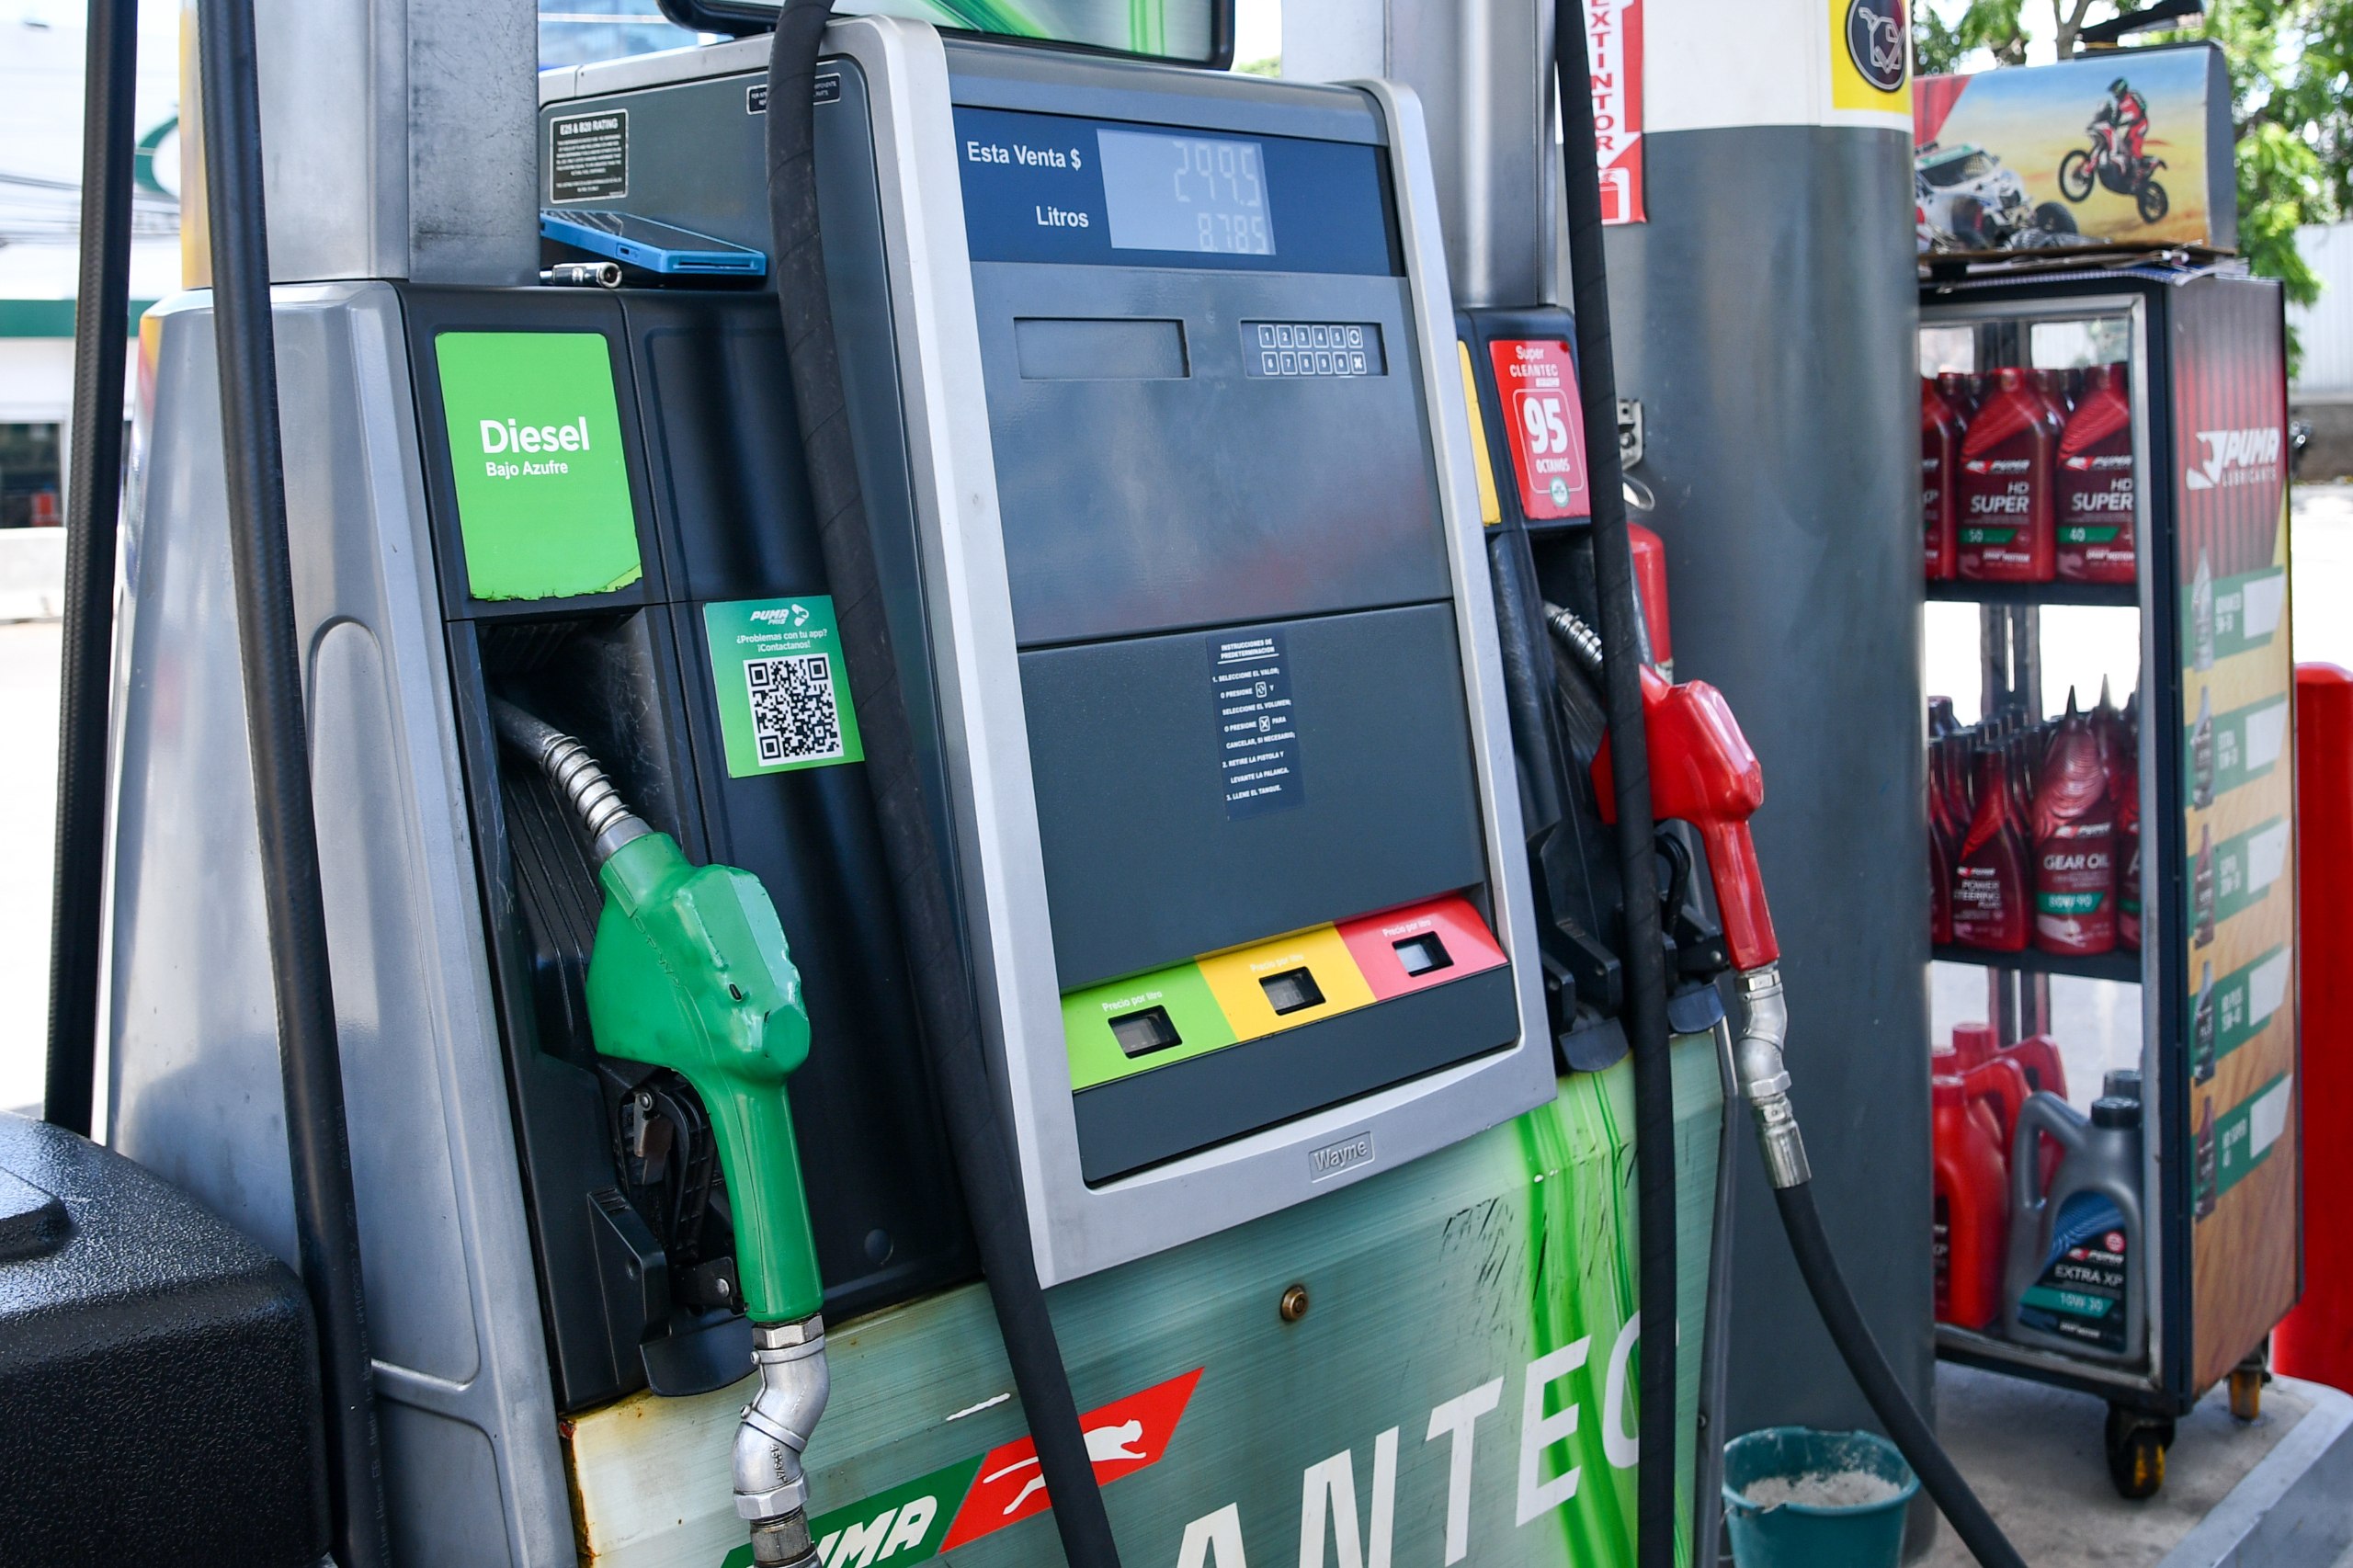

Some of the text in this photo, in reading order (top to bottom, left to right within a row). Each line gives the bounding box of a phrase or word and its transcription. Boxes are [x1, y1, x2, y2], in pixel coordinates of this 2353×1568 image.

[592, 118, 619, 131] RATING
[967, 141, 1082, 171] Esta Venta $
[1036, 205, 1089, 228] Litros
[1265, 332, 1340, 341] 1 2 3 4 5
[1516, 345, 1544, 362] Super
[1267, 358, 1274, 368] 6
[1286, 358, 1290, 368] 7
[1321, 358, 1326, 368] 9
[1338, 358, 1344, 368] 0
[1509, 363, 1559, 378] CLEANTEC
[1523, 397, 1567, 454] 95
[480, 416, 590, 453] Diesel
[2222, 427, 2280, 468] PUMA
[485, 460, 569, 480] Bajo Azufre
[1536, 458, 1571, 473] OCTANOS
[2007, 482, 2029, 494] HD
[2111, 478, 2132, 492] HD
[1971, 496, 2029, 514] SUPER
[2072, 493, 2133, 511] SUPER
[750, 608, 790, 621] PUMA
[736, 628, 827, 644] ¿Problemas con tu app?
[1221, 638, 1273, 652] INSTRUCCIONES DE
[1219, 671, 1252, 683] SELECCIONE
[1225, 687, 1253, 699] PRESIONE
[1222, 704, 1256, 716] SELECCIONE
[1230, 721, 1257, 732] PRESIONE
[1272, 716, 1287, 724] PARA
[1226, 738, 1256, 749] CANCELAR,
[1229, 757, 1248, 767] RETIRE
[1256, 752, 1279, 762] PISTOLA
[1231, 773, 1255, 784] LEVANTE
[1264, 767, 1290, 778] PALANCA.
[1233, 790, 1250, 800] LLENE
[1258, 785, 1282, 794] TANQUE.
[2044, 853, 2109, 870] GEAR OIL
[1961, 880, 2000, 892] POWER
[1381, 926, 1405, 937] Precio
[1405, 923, 1418, 933] por
[1250, 961, 1276, 971] Precio
[1102, 991, 1163, 1012] Precio por litro
[1313, 1141, 1368, 1172] Wayne
[2054, 1265, 2124, 1286] EXTRA XP
[2060, 1292, 2086, 1310] 10W
